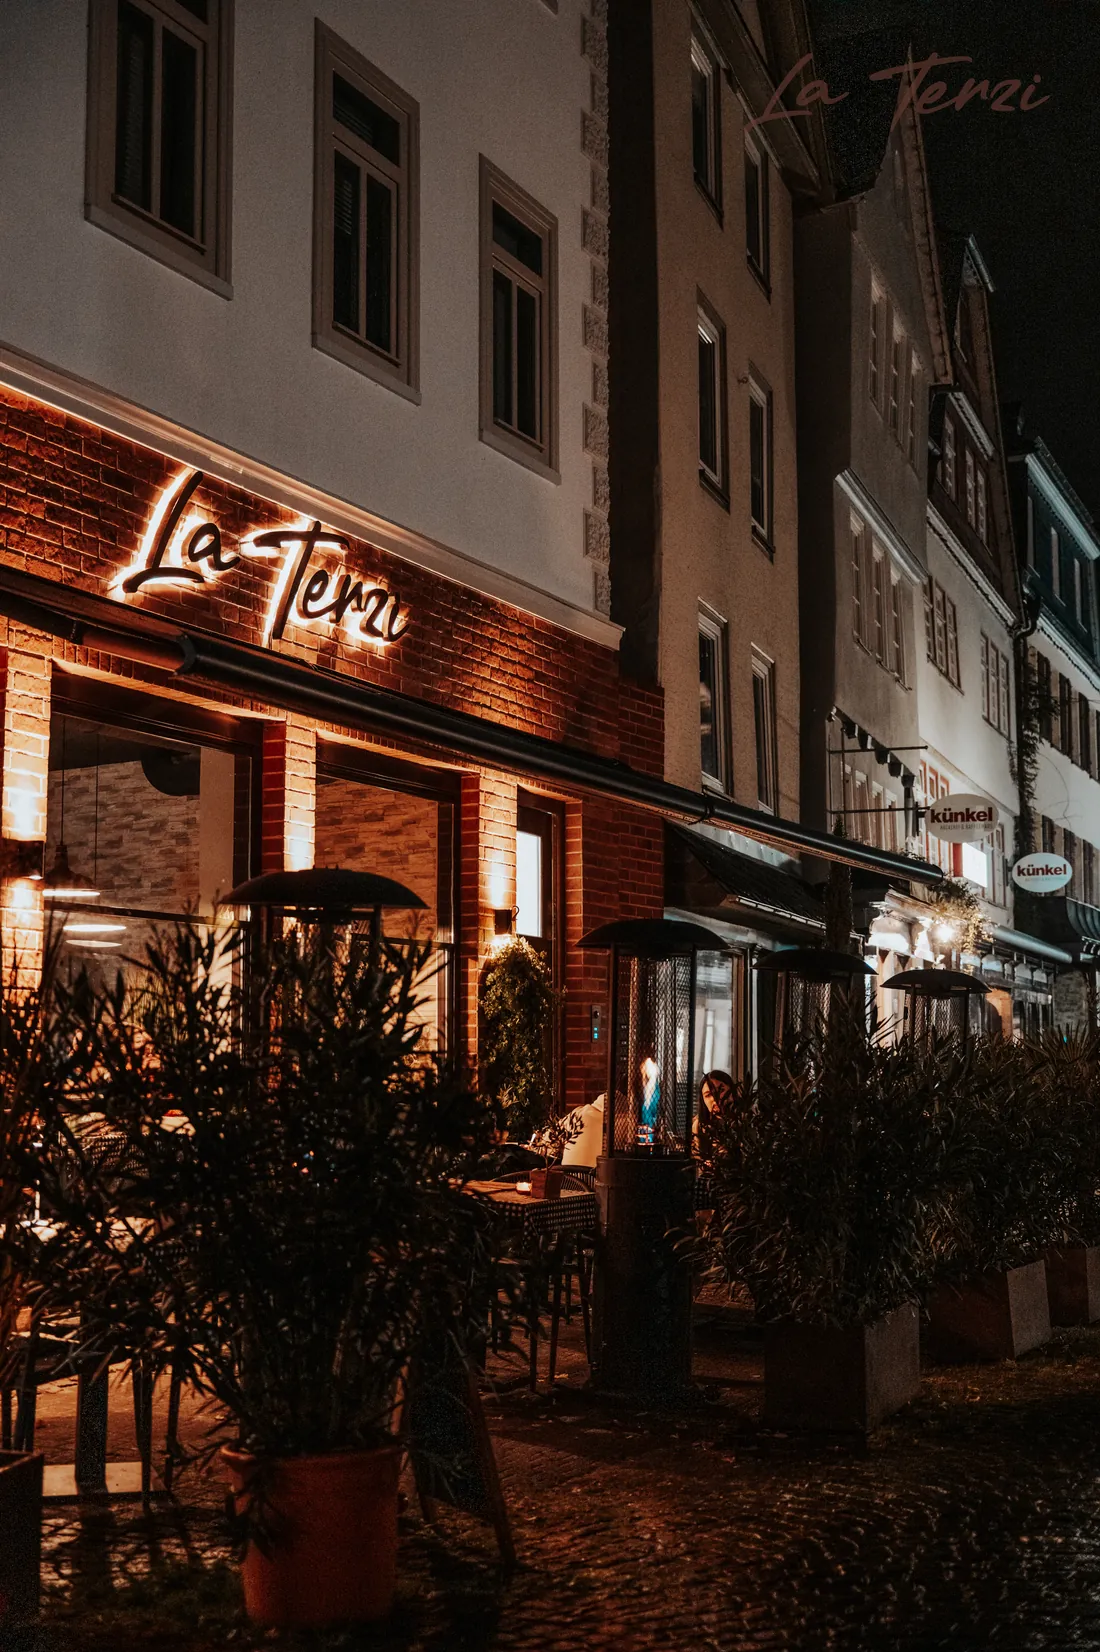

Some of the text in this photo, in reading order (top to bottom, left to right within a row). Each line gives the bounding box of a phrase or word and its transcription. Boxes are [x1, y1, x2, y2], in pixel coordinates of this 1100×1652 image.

[122, 470, 411, 642] La Terzi
[930, 806, 993, 823] künkel
[1017, 864, 1067, 876] künkel
